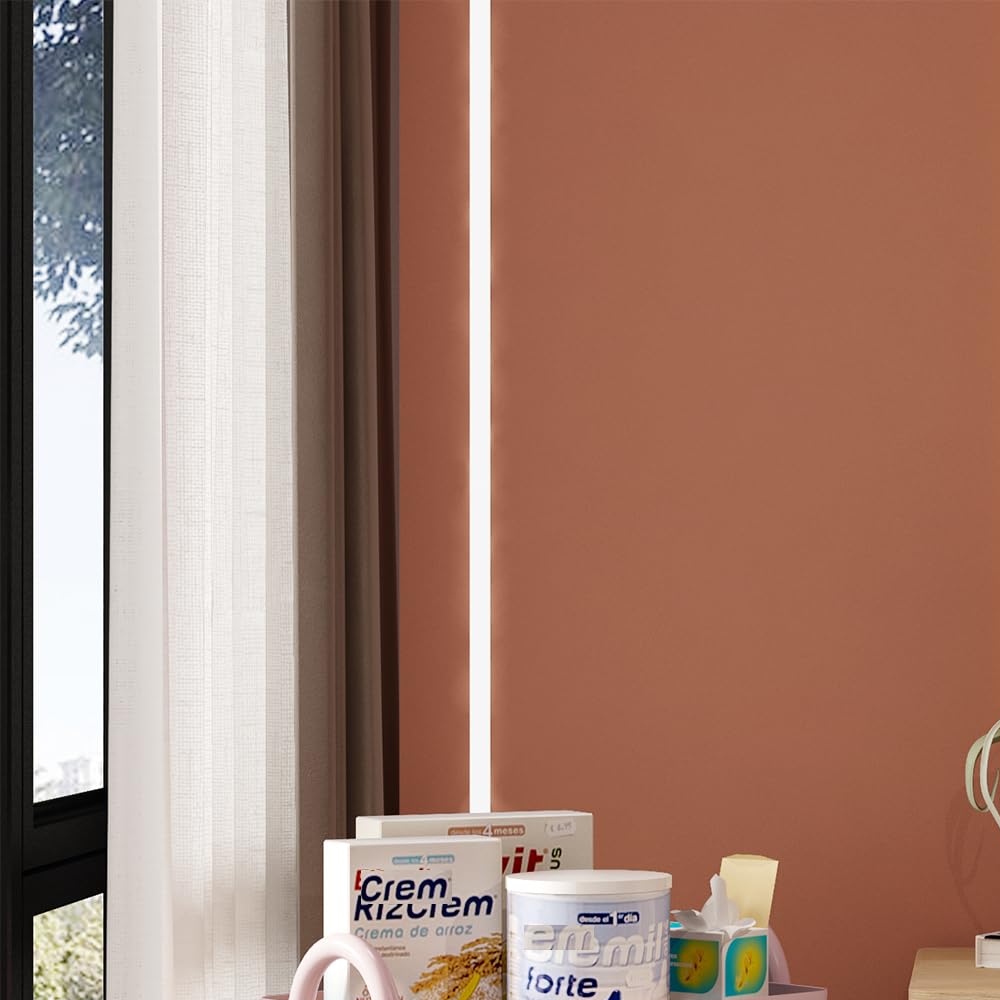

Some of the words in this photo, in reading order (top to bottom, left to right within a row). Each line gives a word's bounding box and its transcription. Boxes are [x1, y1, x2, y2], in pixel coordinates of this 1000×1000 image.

[360, 875, 448, 902] Crem
[410, 925, 429, 938] de
[435, 924, 473, 937] arroz
